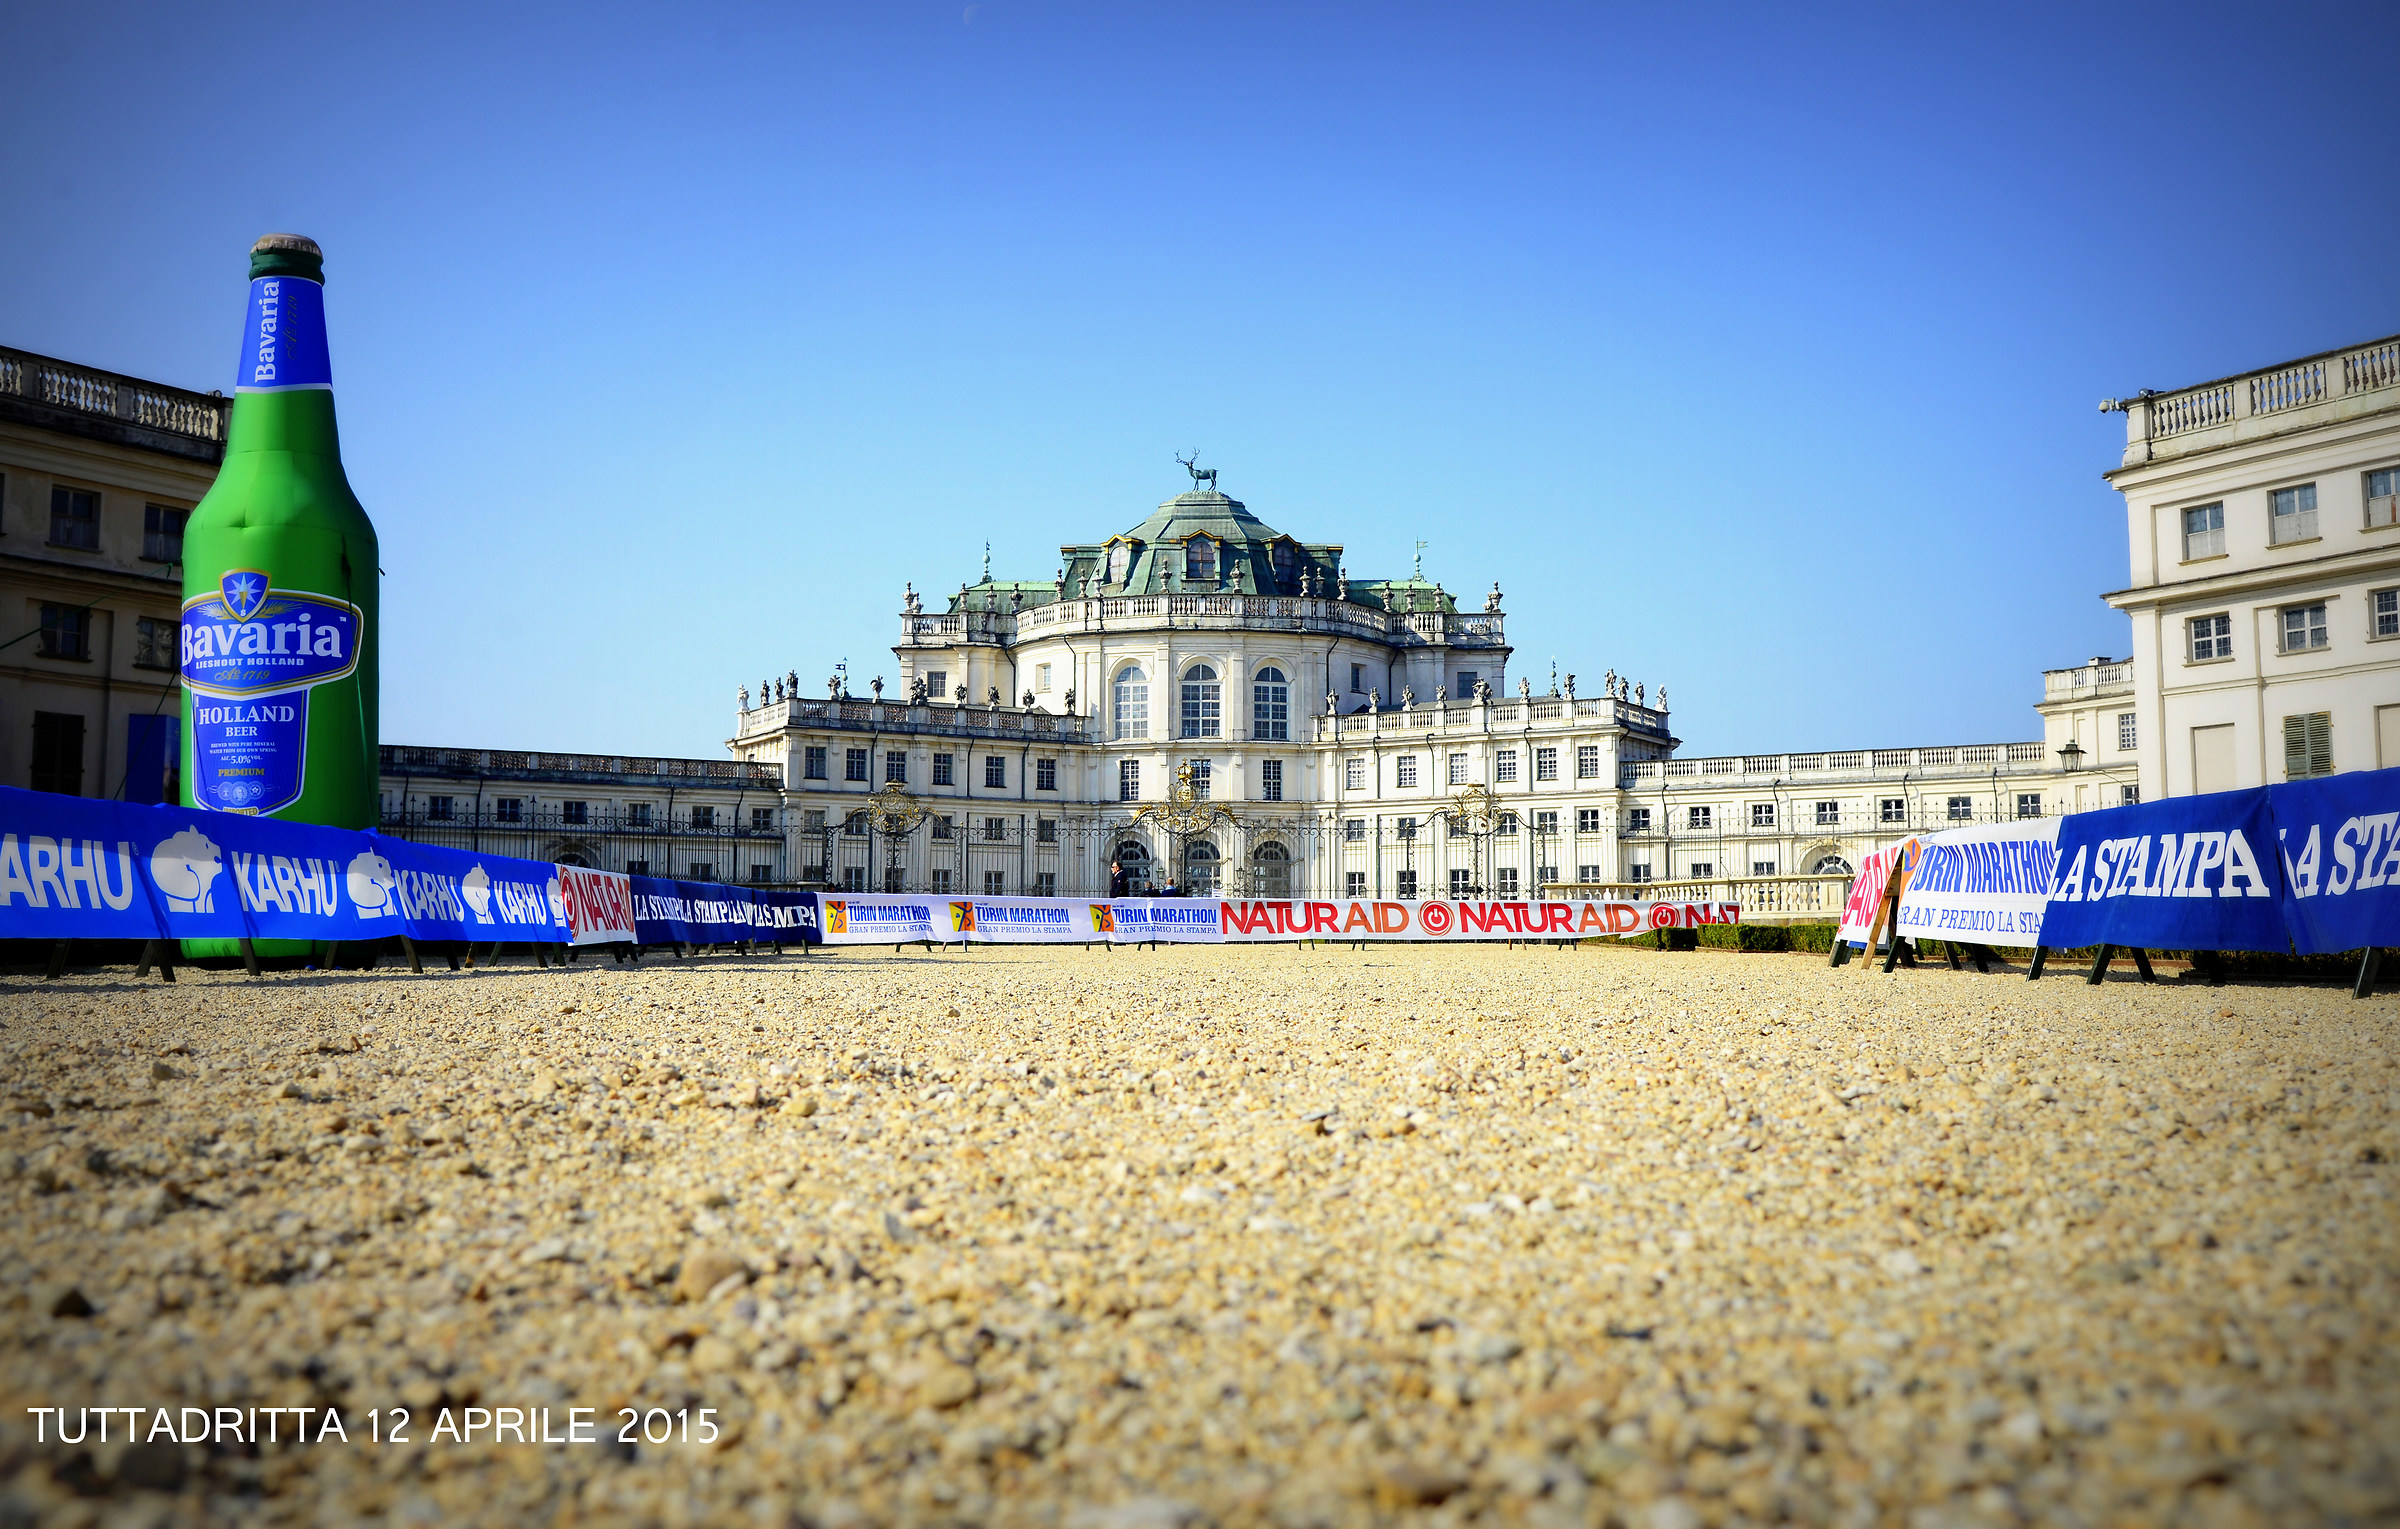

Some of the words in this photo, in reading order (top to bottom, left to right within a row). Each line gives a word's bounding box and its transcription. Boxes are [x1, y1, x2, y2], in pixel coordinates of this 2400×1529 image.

[255, 281, 280, 382] Bavaria
[181, 613, 342, 667] Bavaria
[195, 658, 243, 669] LIESHOUT
[247, 657, 304, 666] HOLLAND
[242, 670, 270, 680] 1719
[199, 706, 295, 725] HOLLAND
[225, 726, 258, 737] BEER
[218, 768, 265, 777] PREMIUM
[0, 832, 133, 911] ARHU
[2088, 829, 2270, 902] STAMPA
[231, 850, 338, 917] KARHU
[394, 869, 465, 923] KARHU
[493, 880, 547, 925] KARHU
[634, 895, 649, 920] LA
[848, 905, 876, 922] TURIN
[878, 904, 931, 922] MARATHON
[975, 906, 1008, 923] TURIN
[1009, 907, 1070, 923] MARATHON
[1112, 908, 1148, 924] TURIN
[1150, 908, 1217, 924] MARATHON
[849, 925, 869, 934] GRAN
[870, 925, 896, 933] PREMIO
[897, 925, 908, 933] LA
[1139, 925, 1171, 934] PREMIO
[1173, 926, 1184, 934] LA
[1186, 926, 1217, 934] STAMPA
[1937, 909, 1995, 932] PREMIO
[1998, 911, 2015, 932] LA
[1000, 926, 1030, 934] PREMIO
[1032, 926, 1042, 934] LA
[1043, 926, 1072, 934] STAMPA
